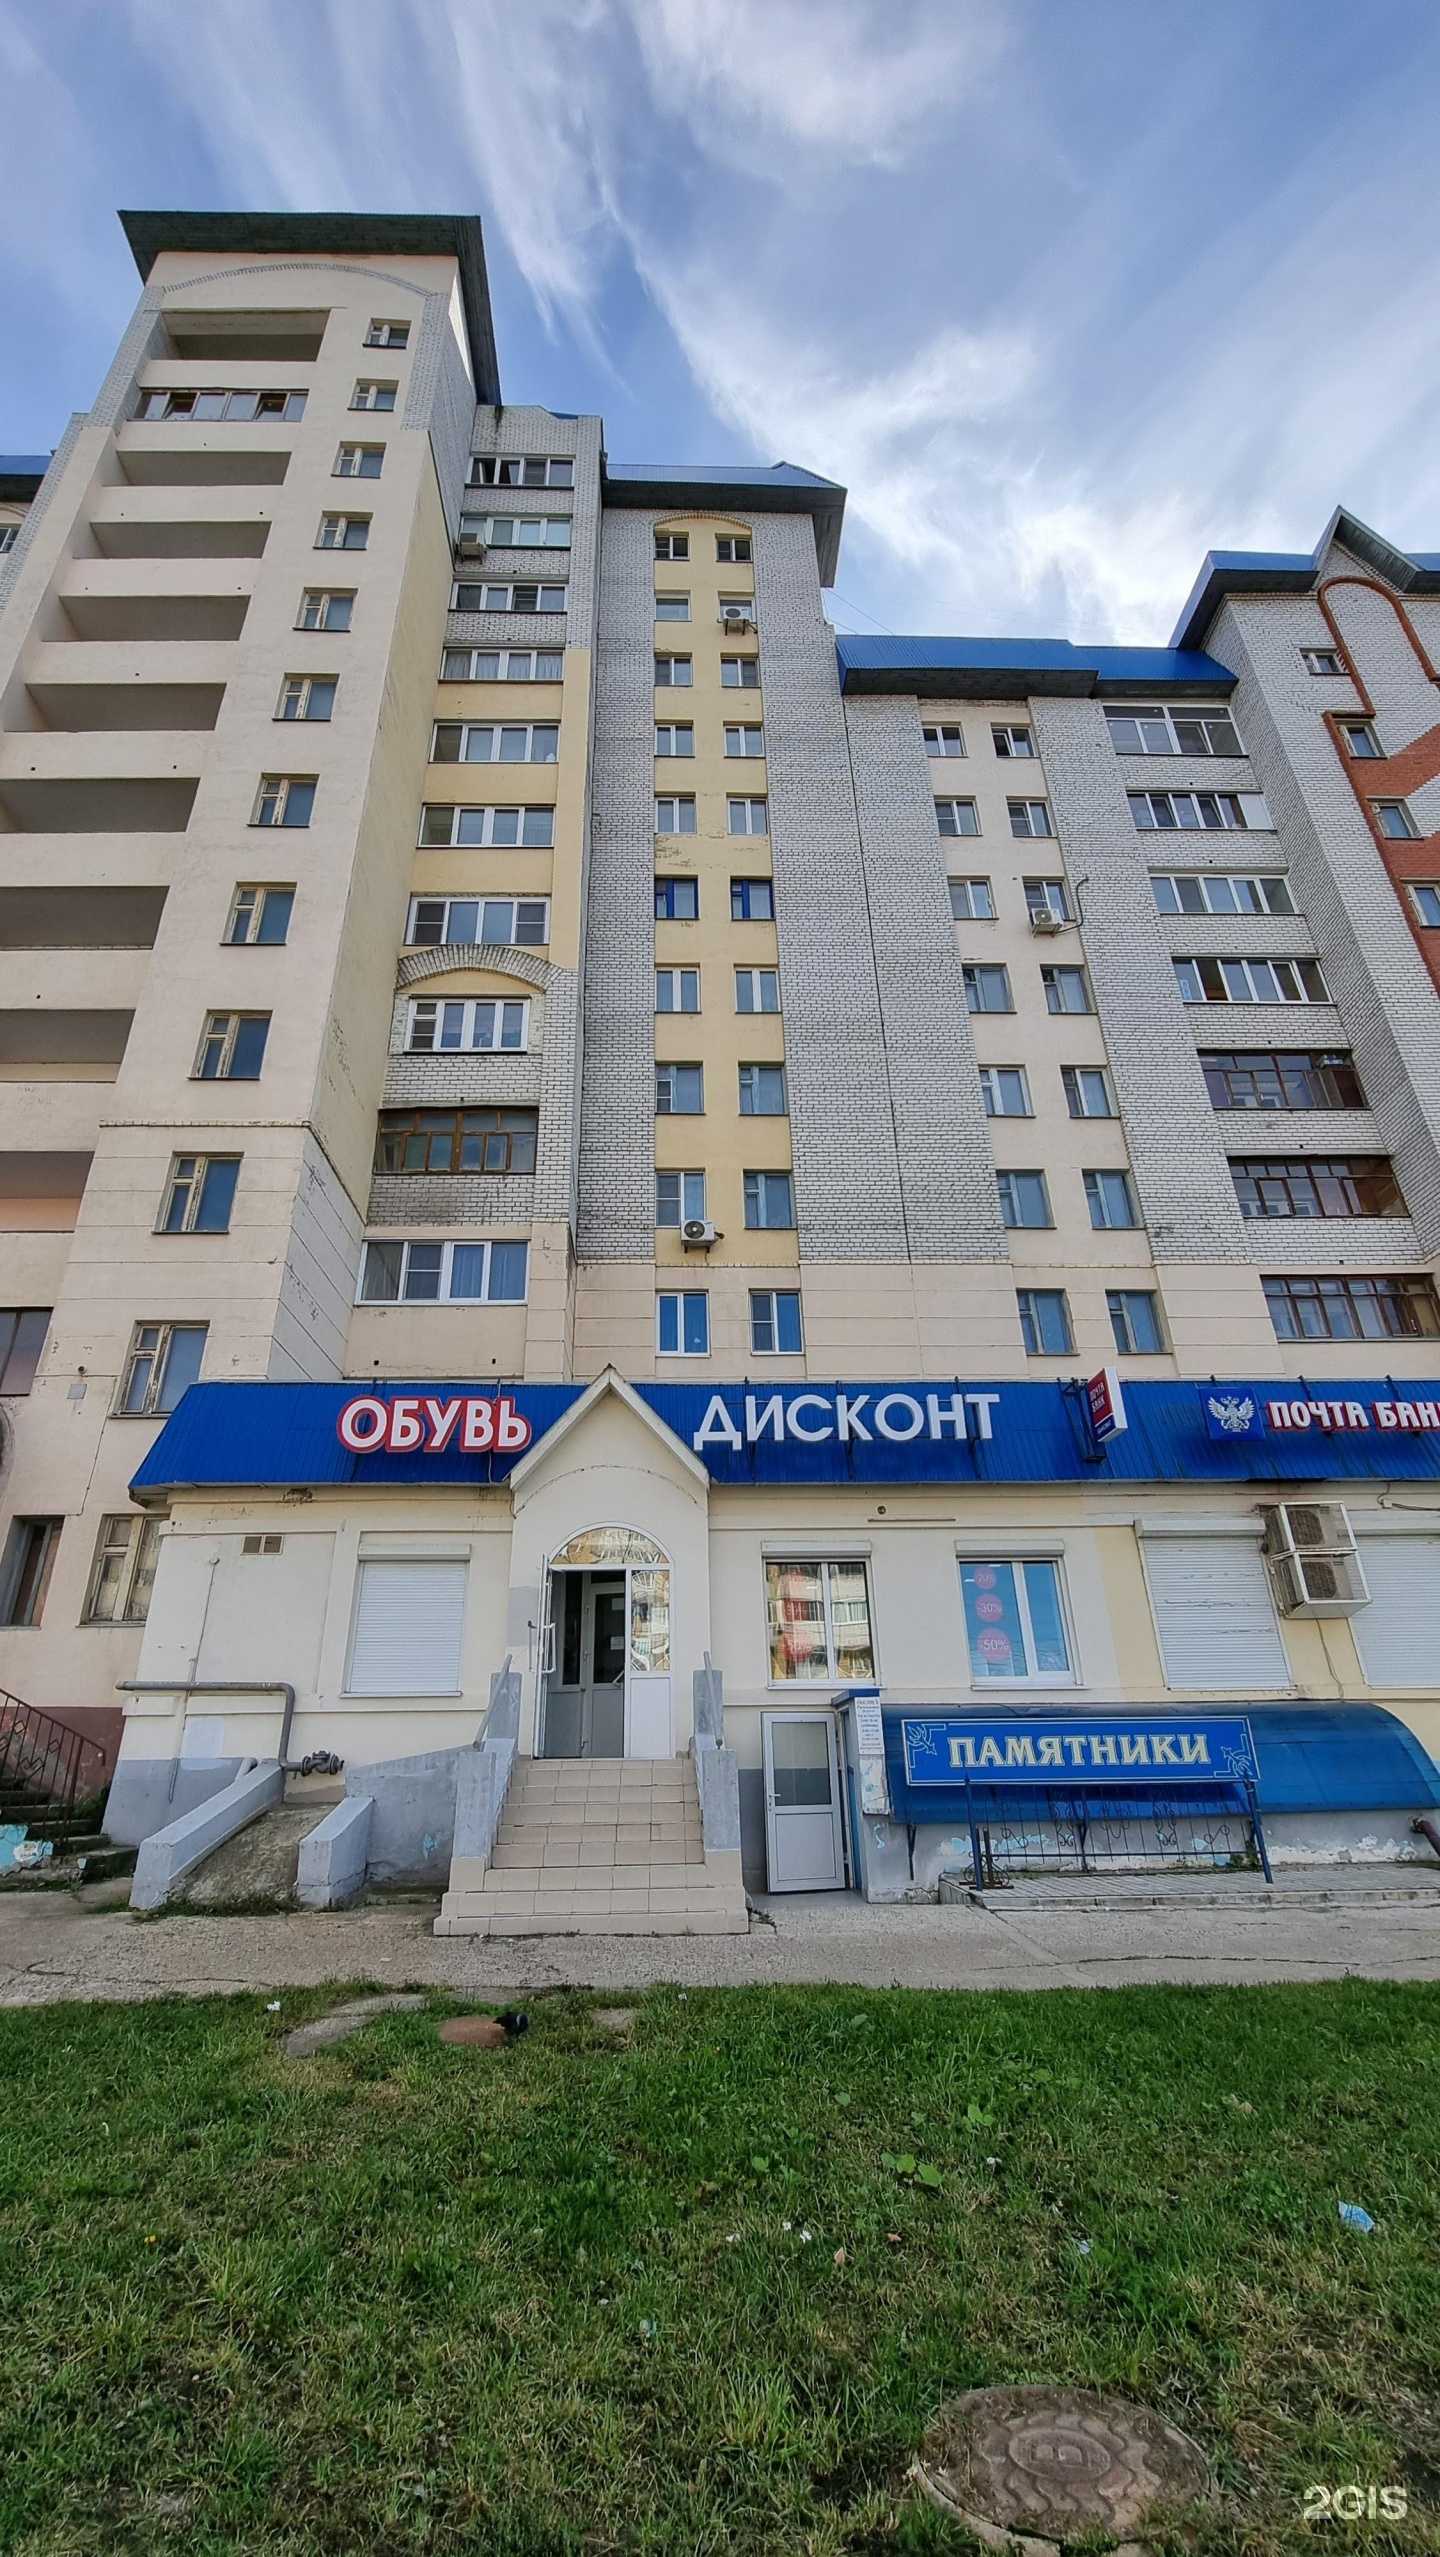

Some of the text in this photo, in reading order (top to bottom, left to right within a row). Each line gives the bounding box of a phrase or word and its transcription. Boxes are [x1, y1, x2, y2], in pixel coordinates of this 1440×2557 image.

[339, 1397, 529, 1449] ОБУВЬ
[693, 1393, 1000, 1451] ДИСКОНТ
[1268, 1401, 1440, 1428] ПОЧТА БАН
[947, 1733, 1211, 1769] ПАМЯТНИКИ
